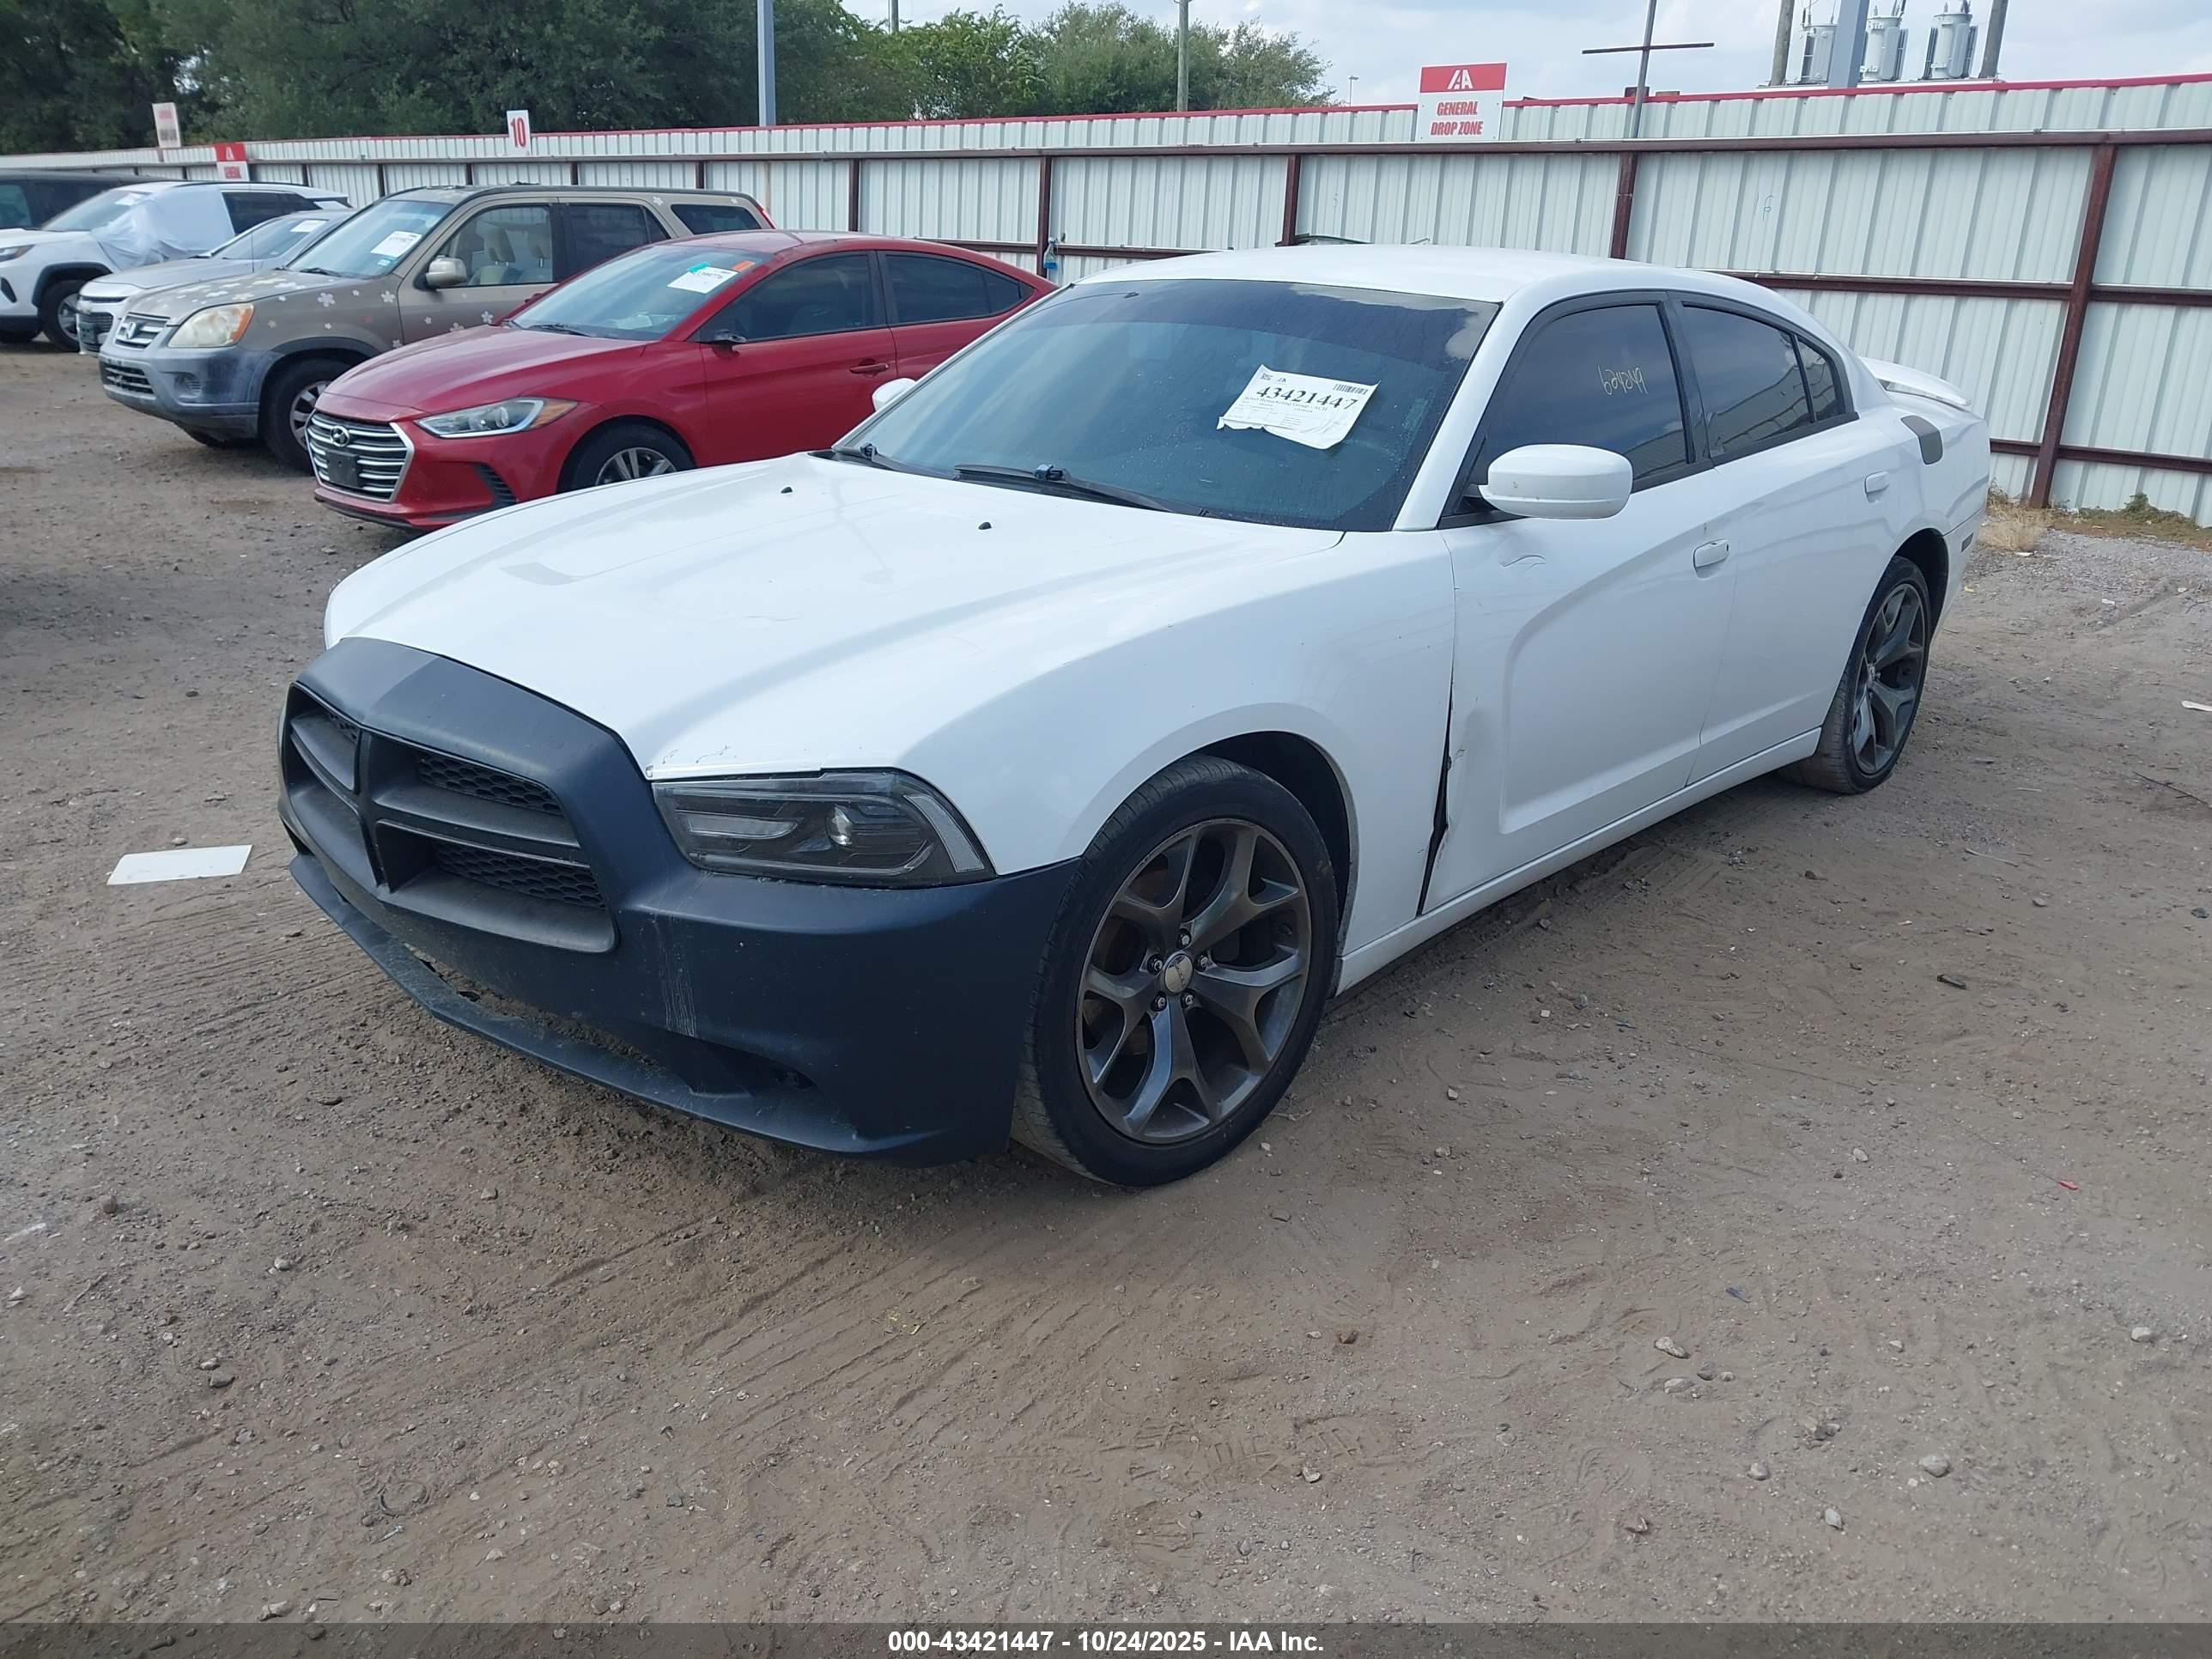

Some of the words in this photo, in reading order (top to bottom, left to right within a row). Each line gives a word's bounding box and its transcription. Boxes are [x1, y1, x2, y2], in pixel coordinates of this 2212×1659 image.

[1437, 100, 1479, 117] GENERAL
[510, 117, 526, 148] 10
[1430, 121, 1458, 136] DROP
[1457, 120, 1484, 136] ZONE
[1255, 386, 1358, 410] 43421447
